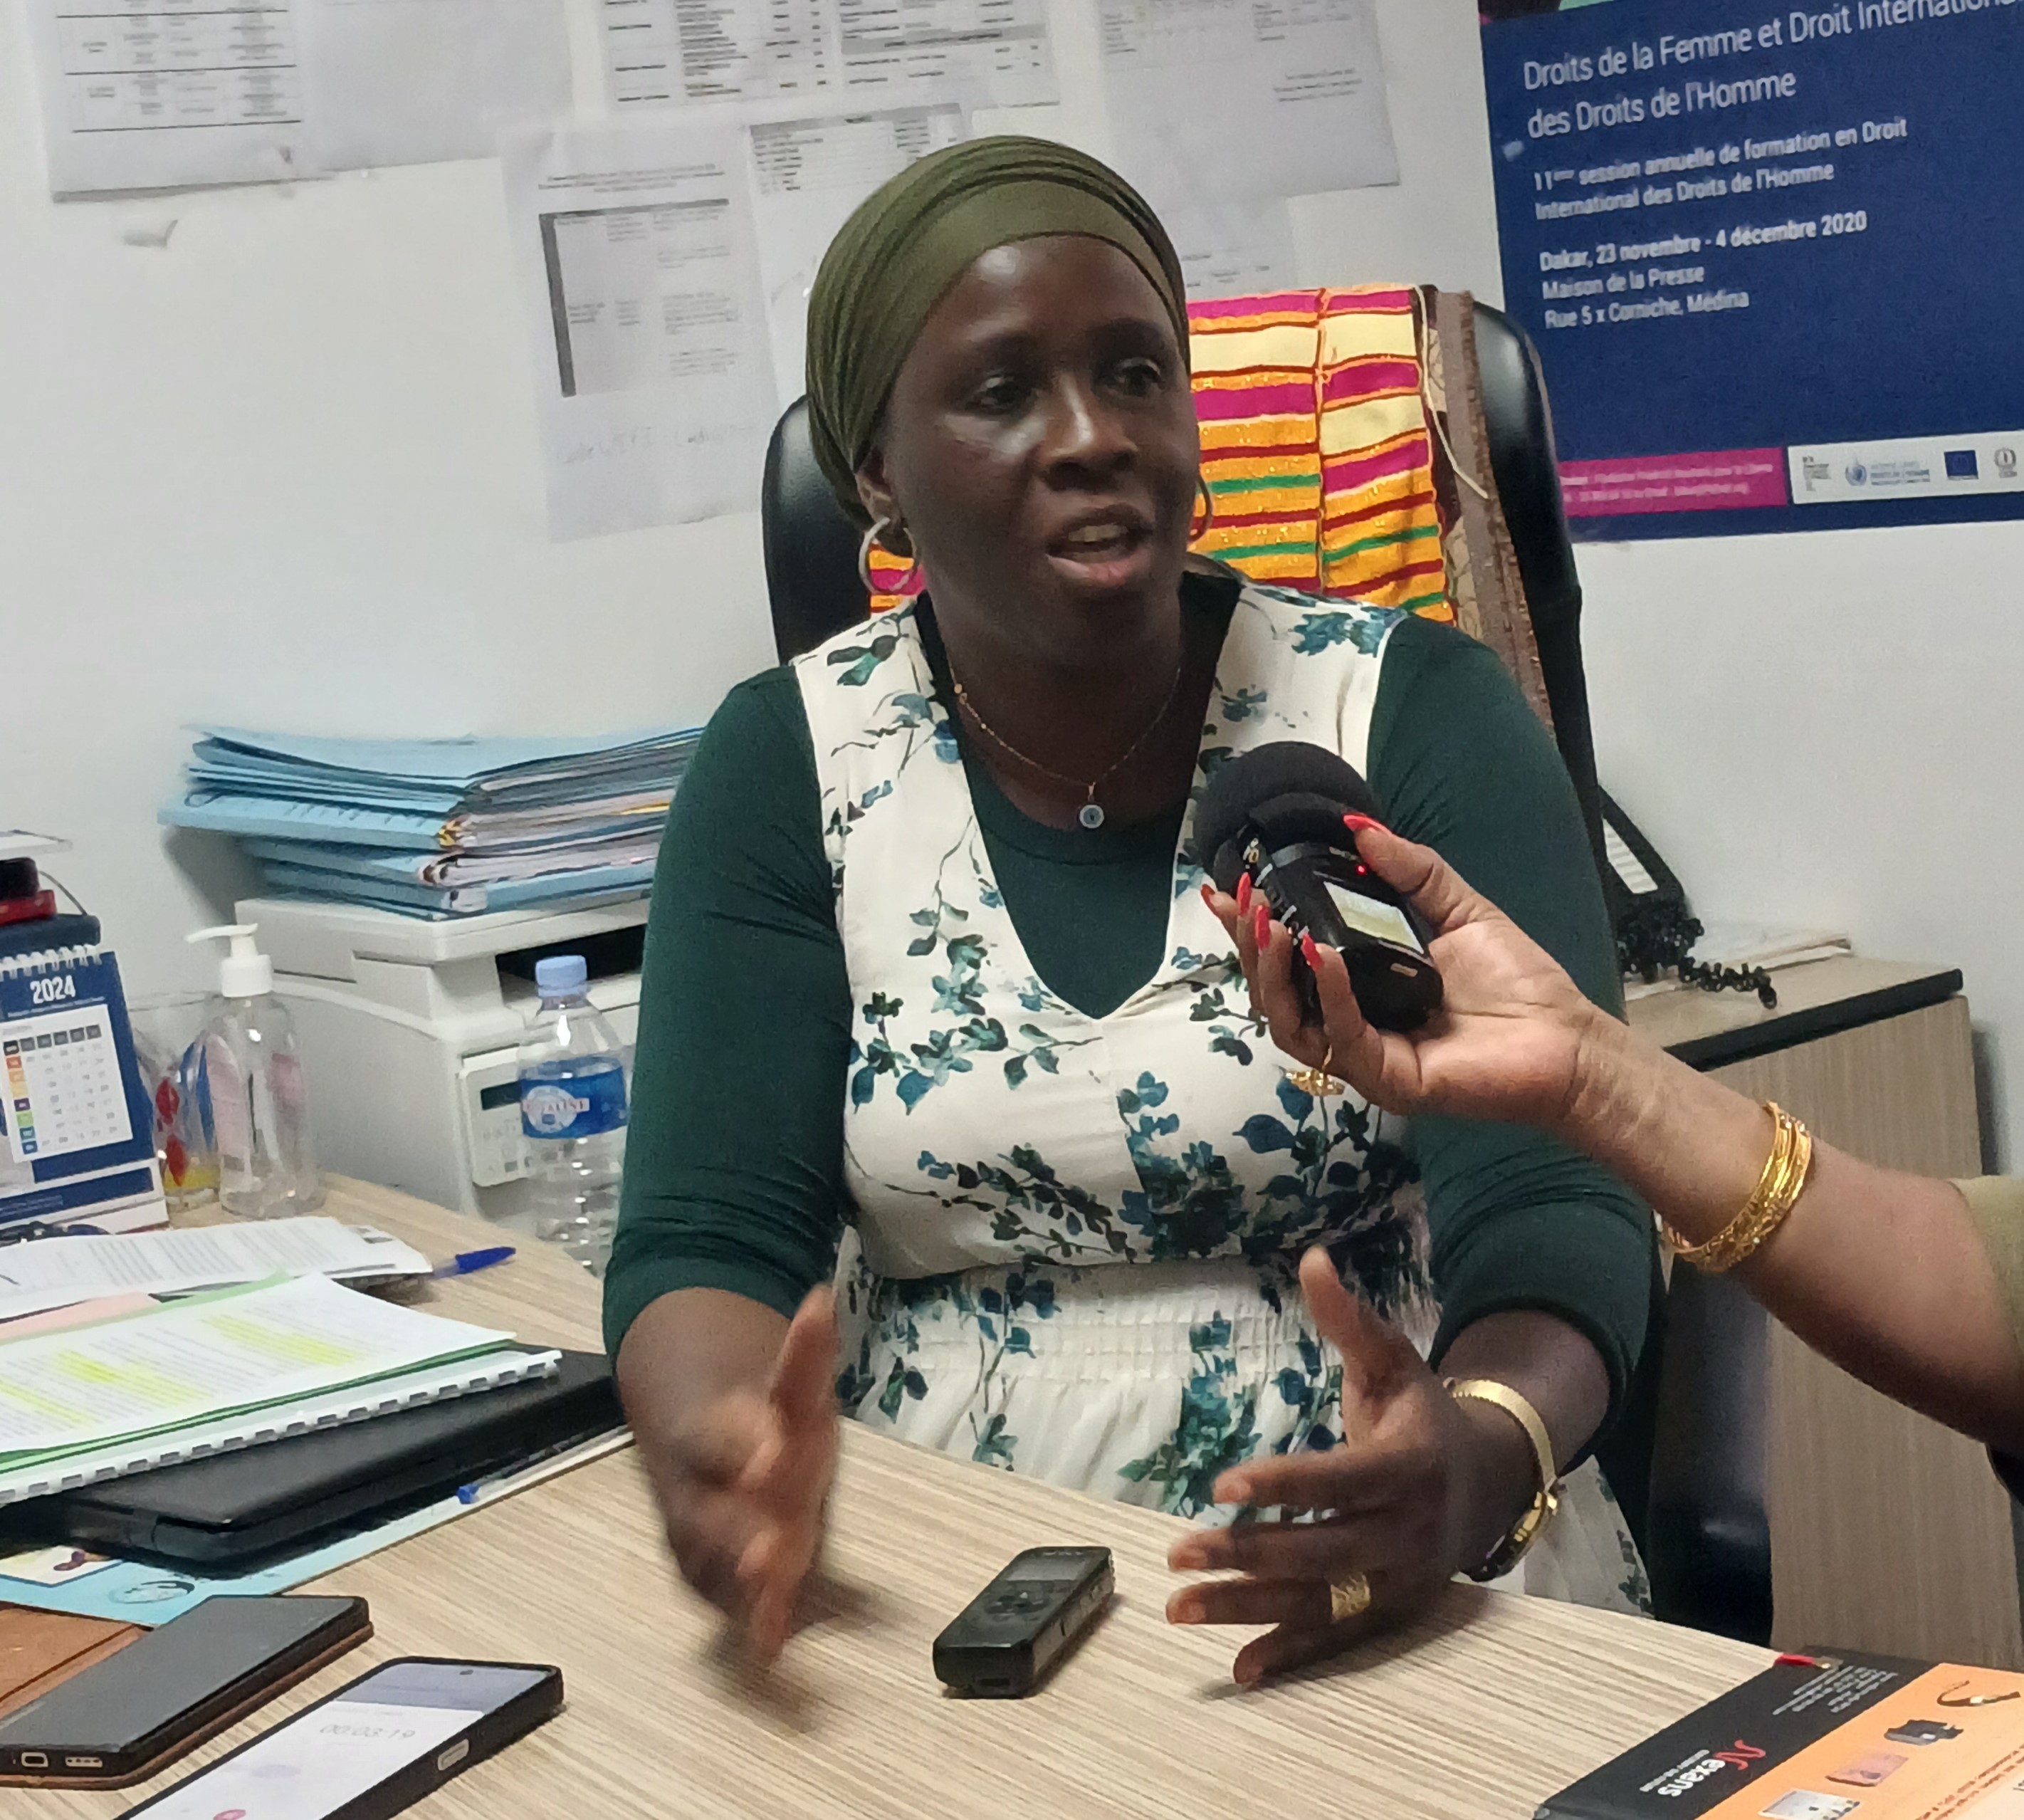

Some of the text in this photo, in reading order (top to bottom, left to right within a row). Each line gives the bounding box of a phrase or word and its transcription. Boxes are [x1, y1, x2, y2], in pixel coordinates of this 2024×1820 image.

[1524, 55, 1593, 90] Droits
[1598, 46, 1627, 77] de
[1632, 41, 1654, 70] la
[1659, 28, 1752, 66] Femme
[1757, 18, 1783, 48] et
[1789, 4, 1852, 43] Droit
[1528, 73, 1796, 138] des Droits de l'Homme
[1579, 159, 1640, 185] session
[1645, 147, 1715, 175] annuelle
[1719, 144, 1740, 164] de
[1745, 131, 1830, 159] formation
[1835, 128, 1857, 147] en
[1862, 116, 1907, 142] Droit
[1535, 188, 1640, 220] International
[1643, 185, 1673, 205] des
[1677, 177, 1727, 201] Droits
[1731, 172, 1753, 193] de
[1539, 249, 1594, 271] Dakar,
[1595, 243, 1617, 264] 23
[1620, 234, 1701, 261] novembre
[1716, 229, 1726, 247] 4
[1731, 220, 1817, 247] décembre
[1821, 210, 1867, 236] 2020
[1542, 266, 1705, 300] Maison de la Presse
[1545, 309, 1578, 329] Rue
[29, 975, 76, 1005] 2024
